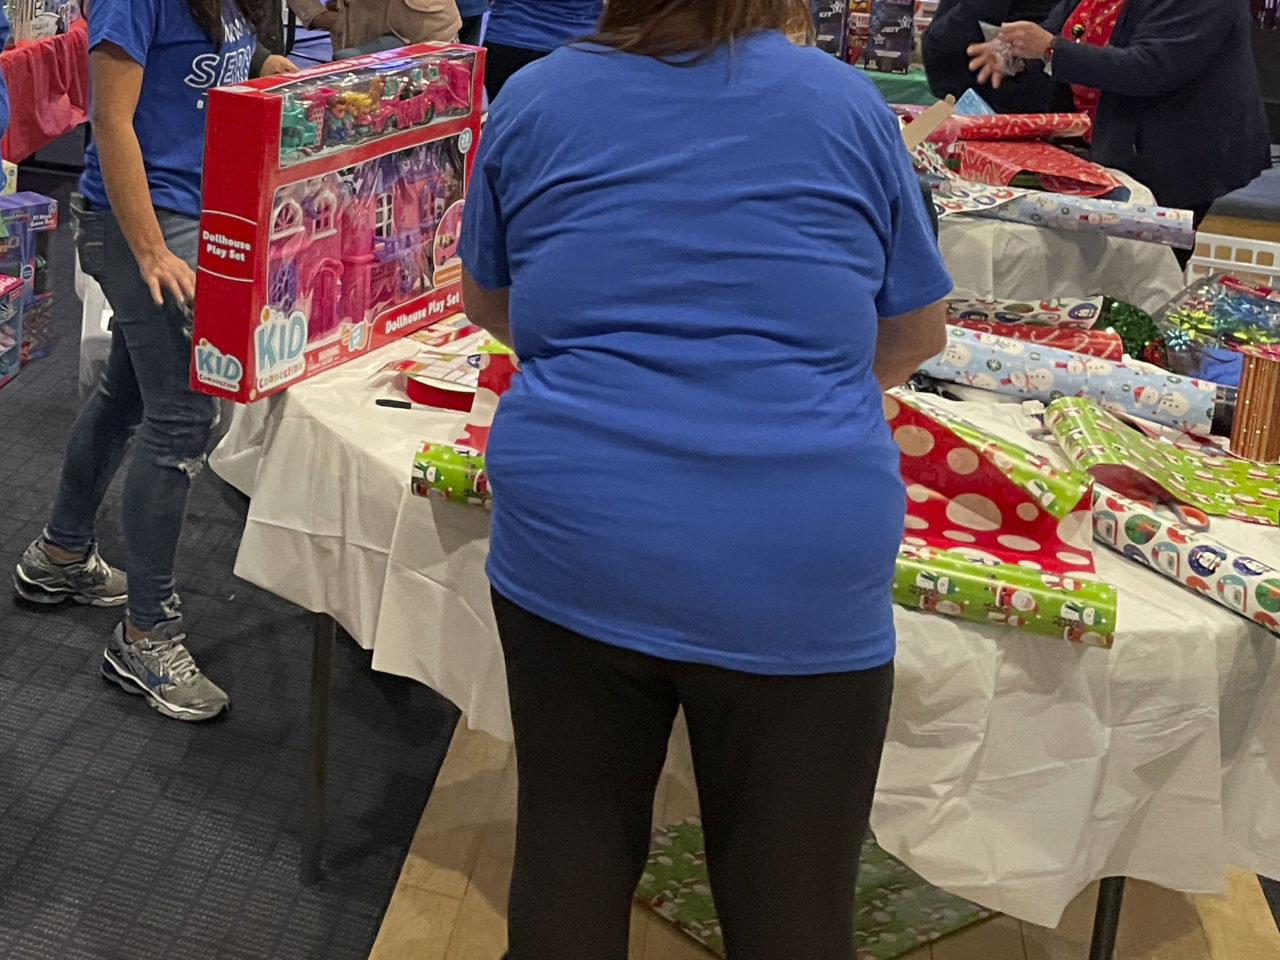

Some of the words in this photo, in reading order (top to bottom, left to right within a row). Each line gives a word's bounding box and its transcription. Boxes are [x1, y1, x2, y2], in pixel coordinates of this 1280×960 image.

[202, 230, 252, 251] Dollhouse
[206, 243, 227, 259] Play
[228, 249, 245, 262] Set
[385, 308, 427, 335] Dollhouse
[428, 299, 445, 315] Play
[446, 291, 460, 307] Set
[258, 315, 306, 372] KID
[197, 348, 240, 380] KID
[259, 363, 303, 389] Connection
